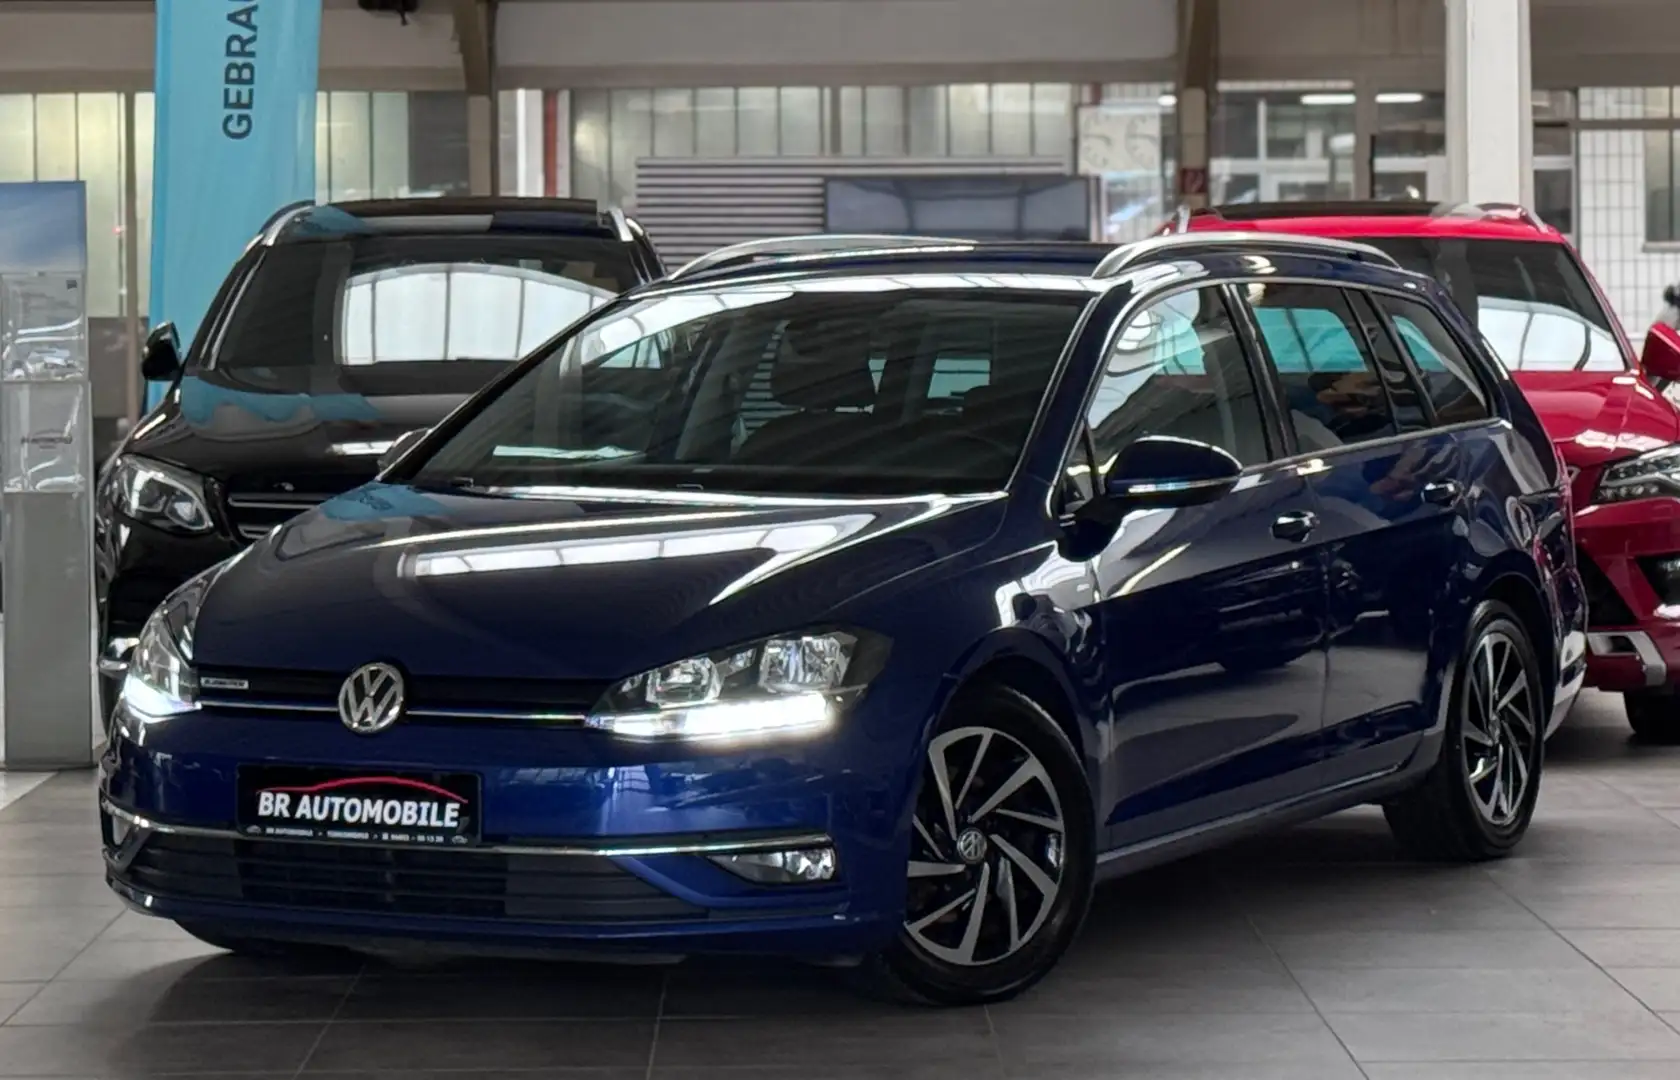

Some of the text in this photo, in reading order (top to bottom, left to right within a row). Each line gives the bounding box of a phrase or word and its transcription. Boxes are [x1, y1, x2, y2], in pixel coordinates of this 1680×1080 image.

[222, 0, 259, 140] GEBRA
[257, 791, 461, 828] BR AUTOMOBILE
